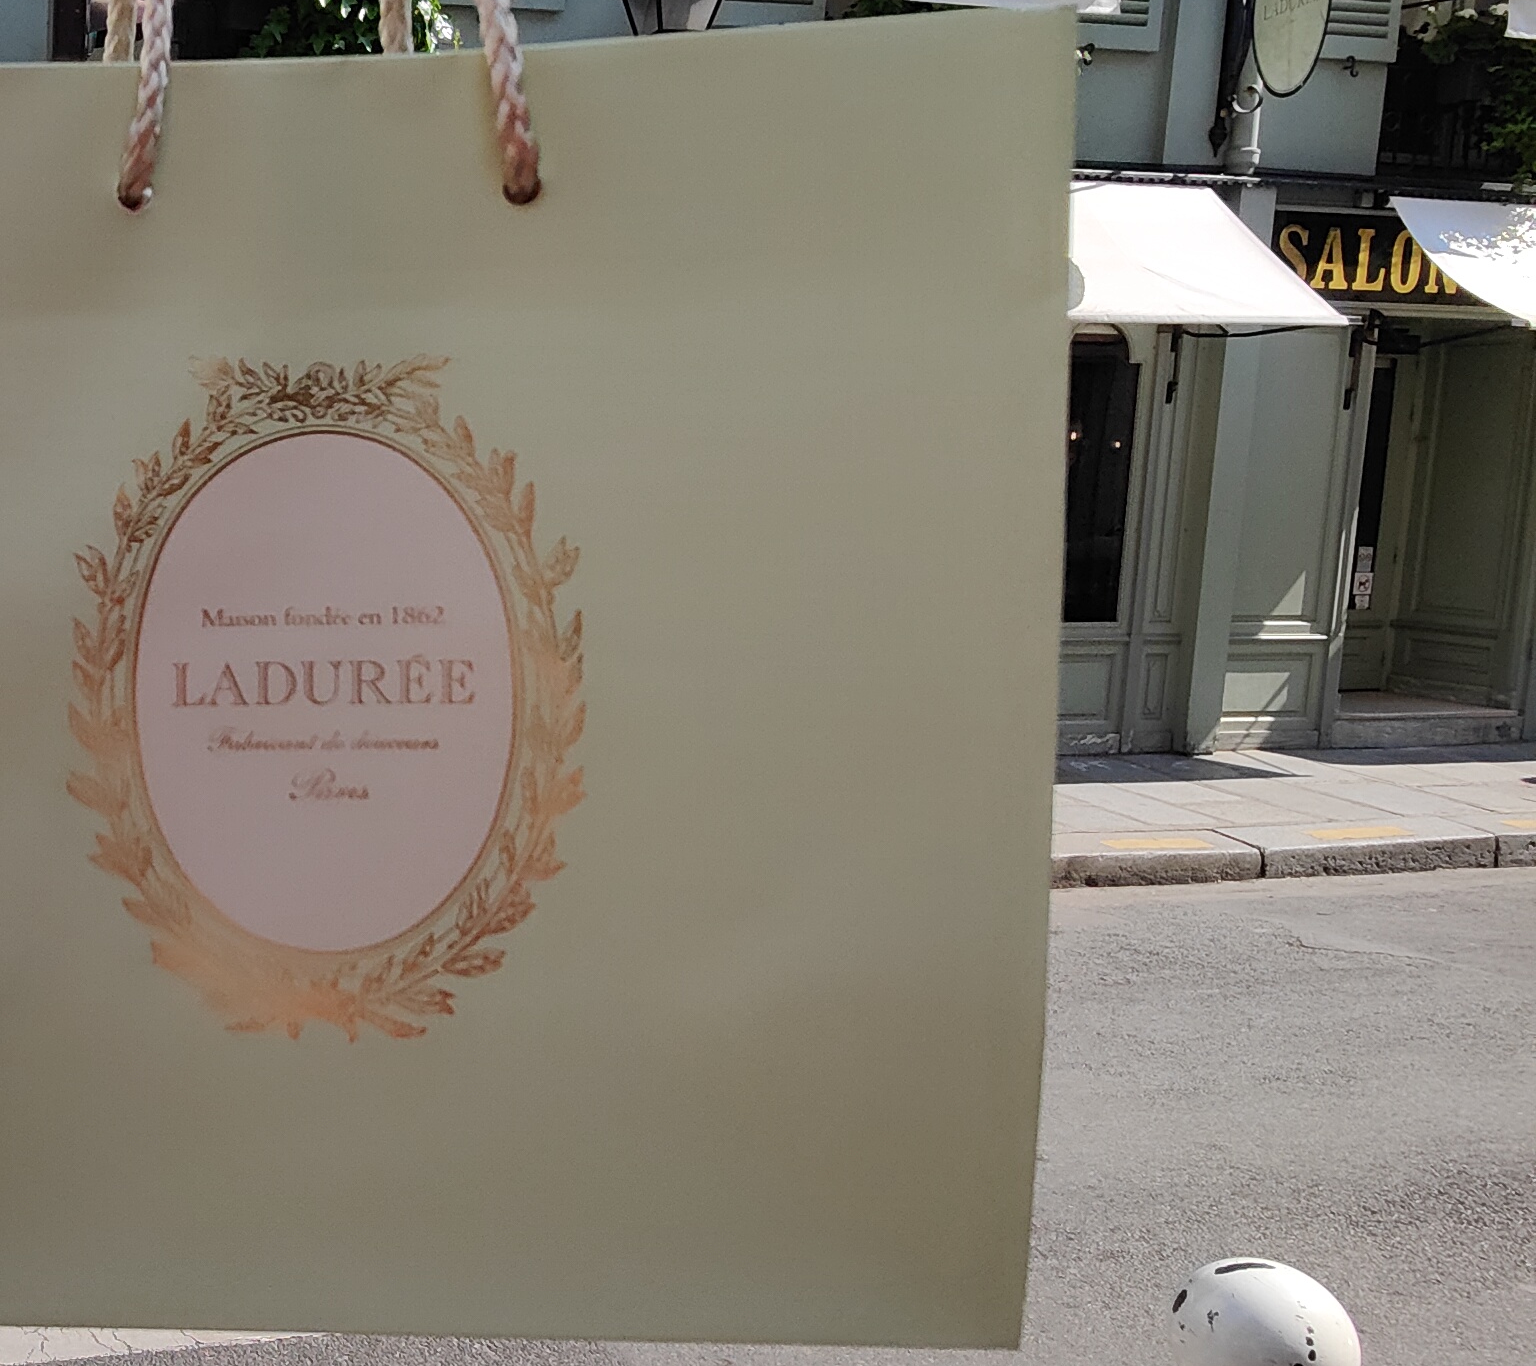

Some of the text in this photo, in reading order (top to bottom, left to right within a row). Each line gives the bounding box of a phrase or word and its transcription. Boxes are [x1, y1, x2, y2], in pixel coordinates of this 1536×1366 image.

[201, 607, 277, 628] Maison
[358, 611, 382, 625] en
[391, 606, 444, 625] 1862
[171, 655, 477, 709] LADURÉE
[289, 768, 370, 801] Paris
